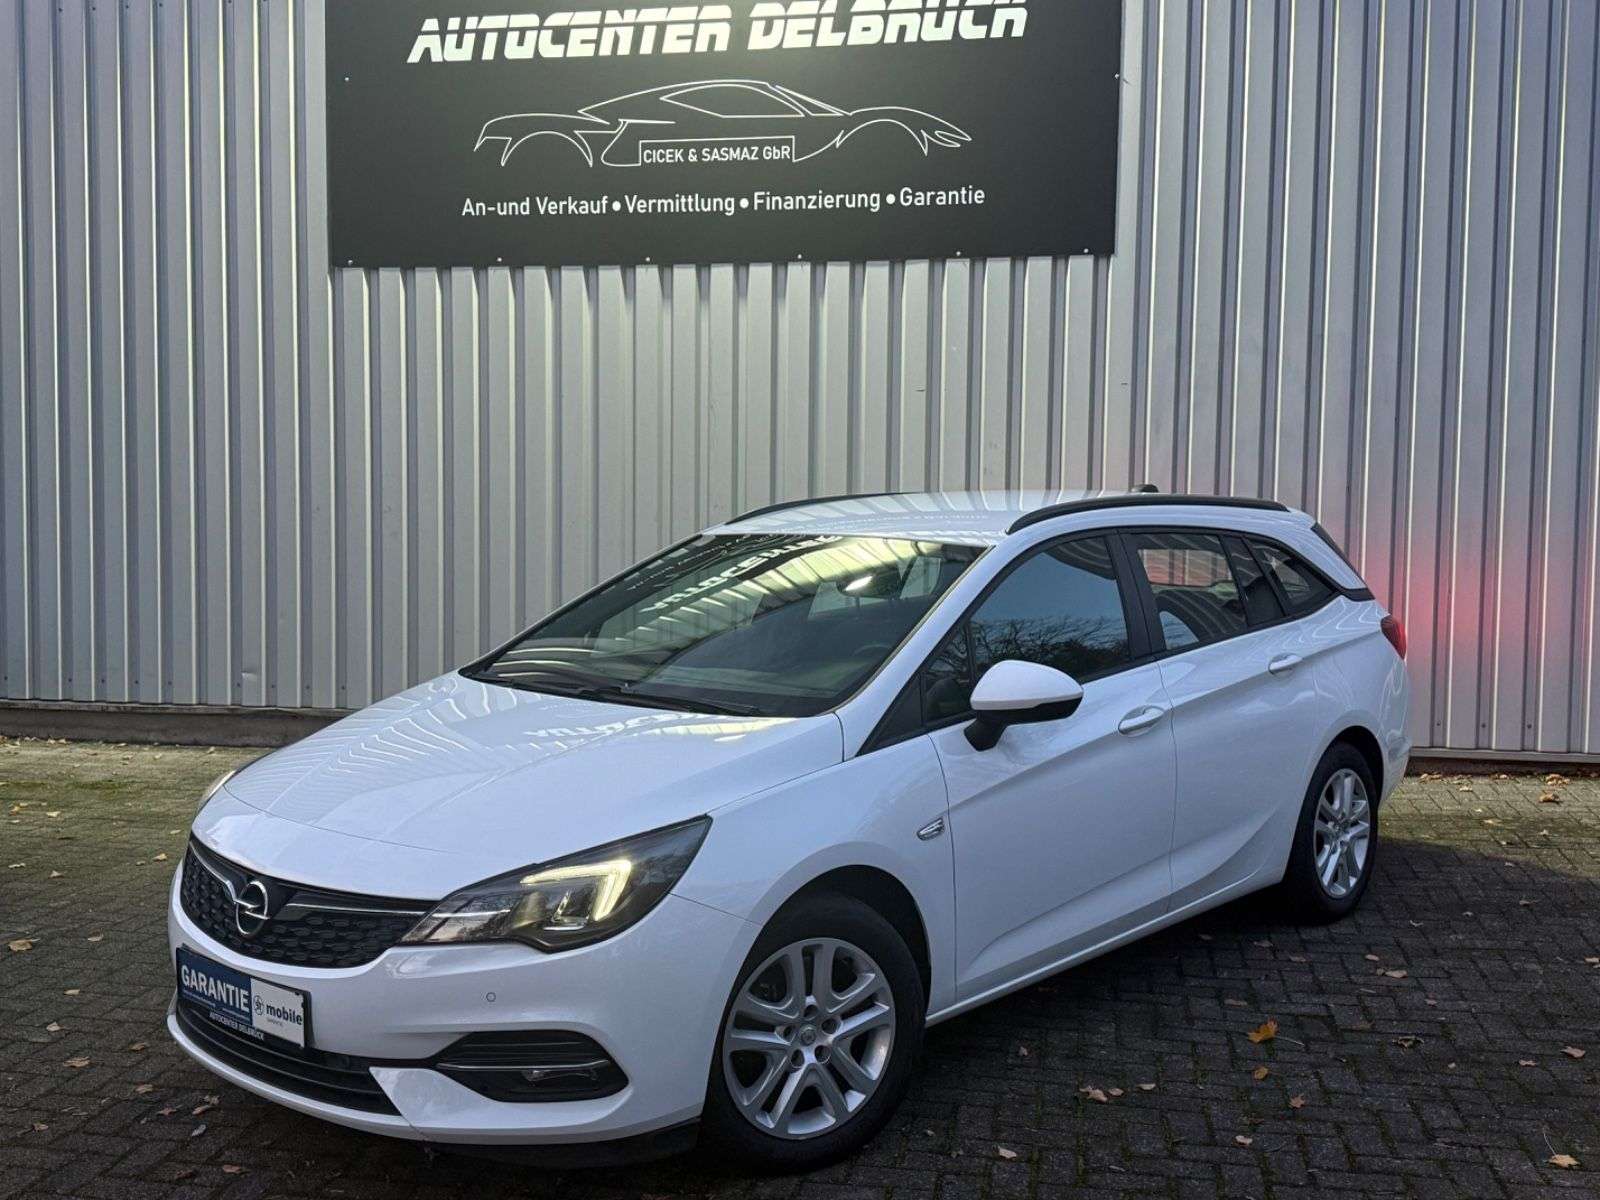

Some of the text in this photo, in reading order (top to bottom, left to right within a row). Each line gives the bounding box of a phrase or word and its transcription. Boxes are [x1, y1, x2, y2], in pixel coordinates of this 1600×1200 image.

[406, 4, 732, 64] AUTOCENTER
[643, 145, 791, 164] CICEK & SASMAZ GbR
[461, 185, 985, 216] An-und Verkauf Vermittlung Finanzierung Garantie
[181, 964, 250, 1013] GARANTIE
[265, 1001, 303, 1026] mobile
